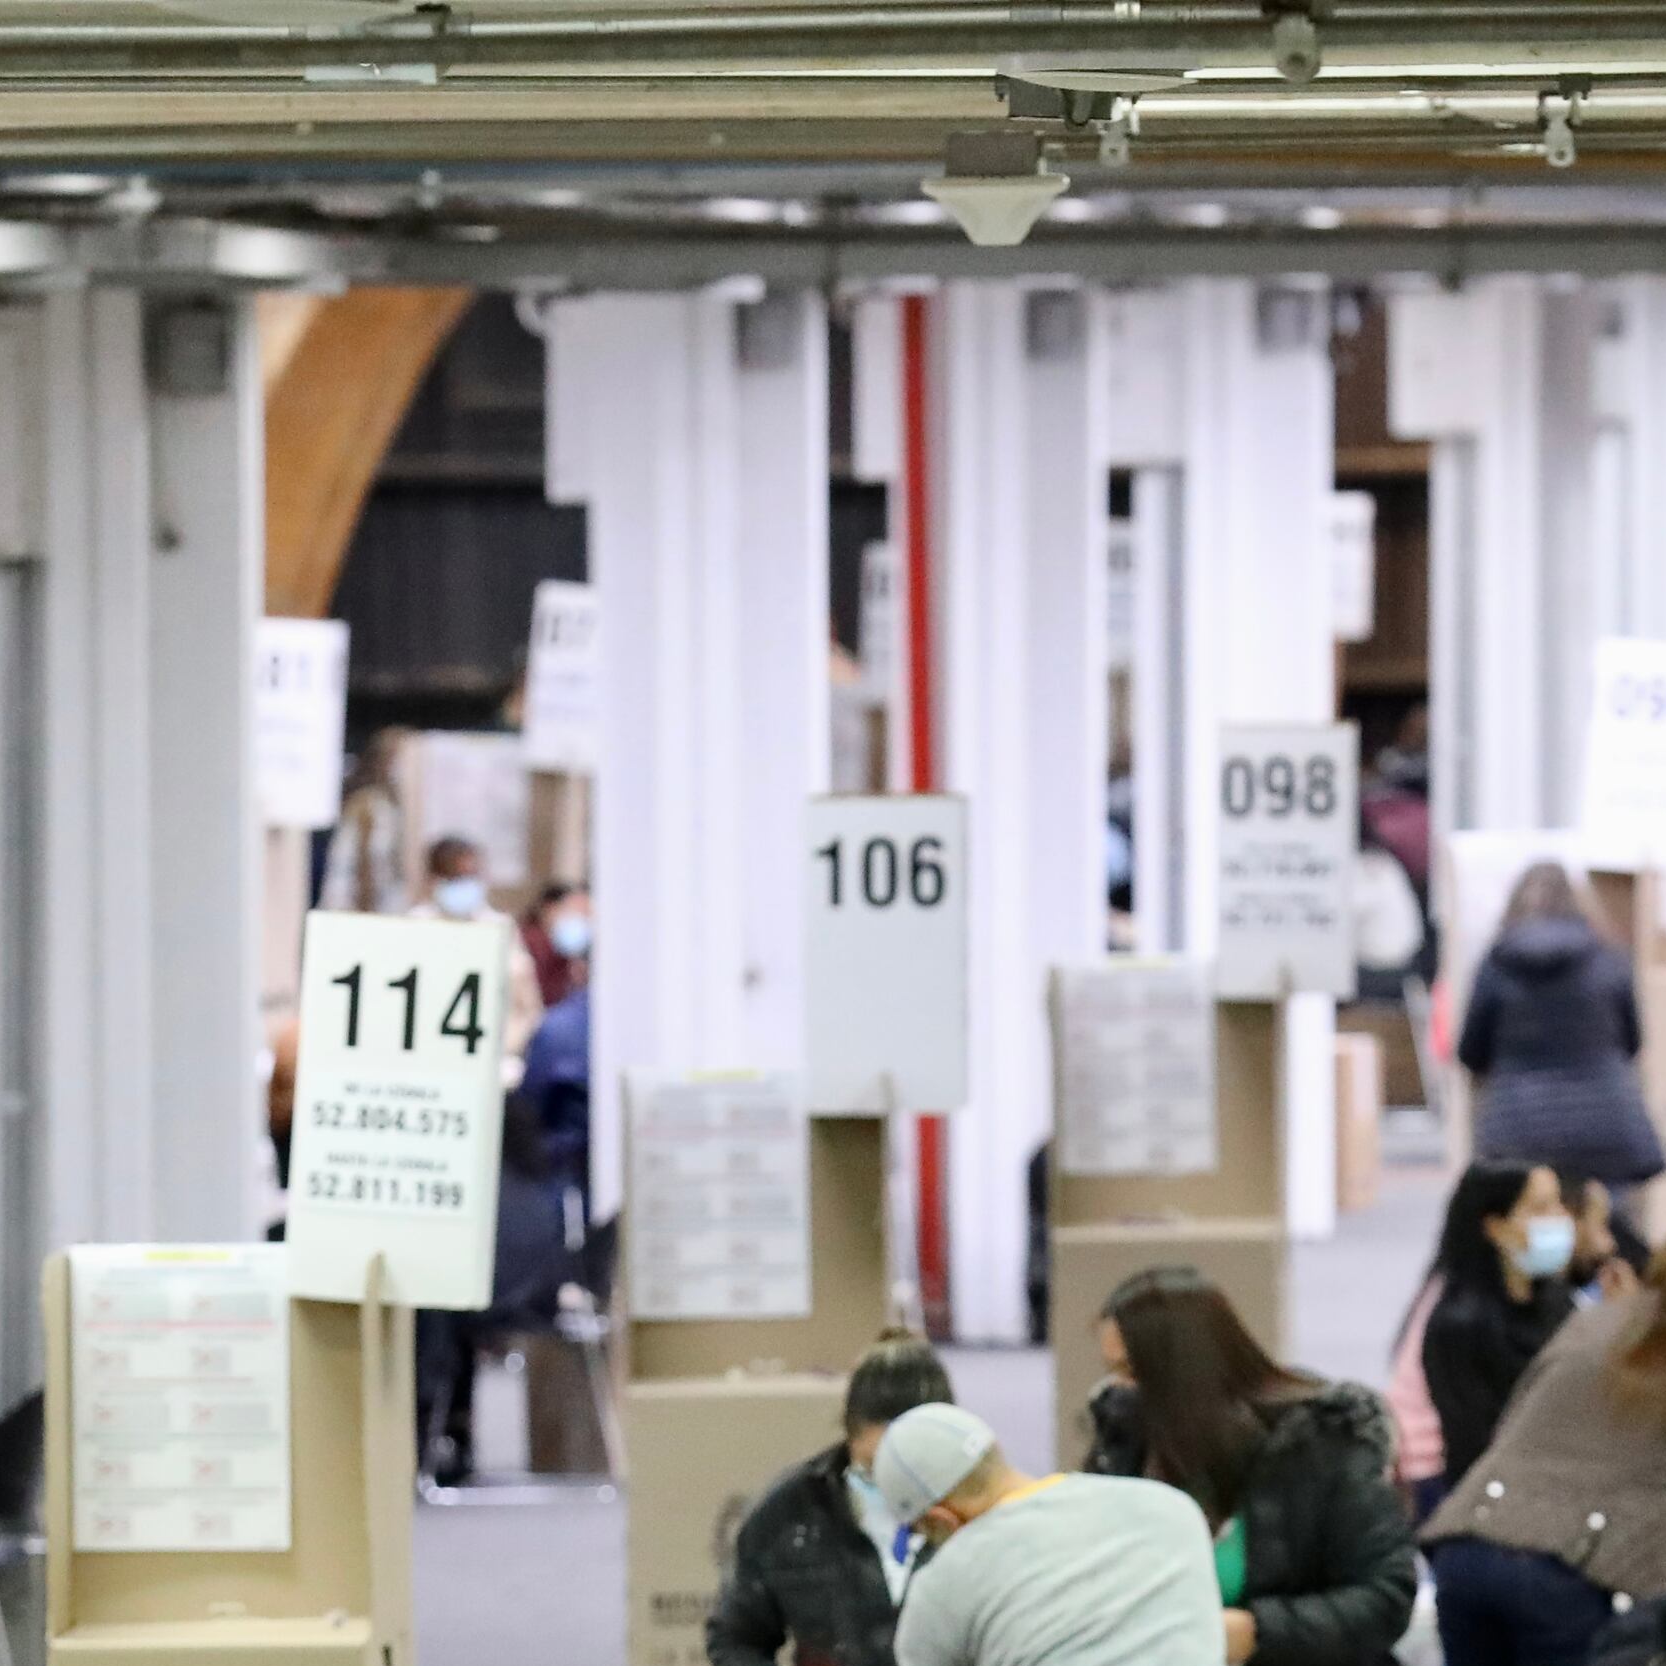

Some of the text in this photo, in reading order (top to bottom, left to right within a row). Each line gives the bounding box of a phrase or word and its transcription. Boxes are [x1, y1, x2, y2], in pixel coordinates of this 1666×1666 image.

[1221, 754, 1336, 818] 098
[815, 834, 947, 909] 106
[331, 961, 485, 1055] 114
